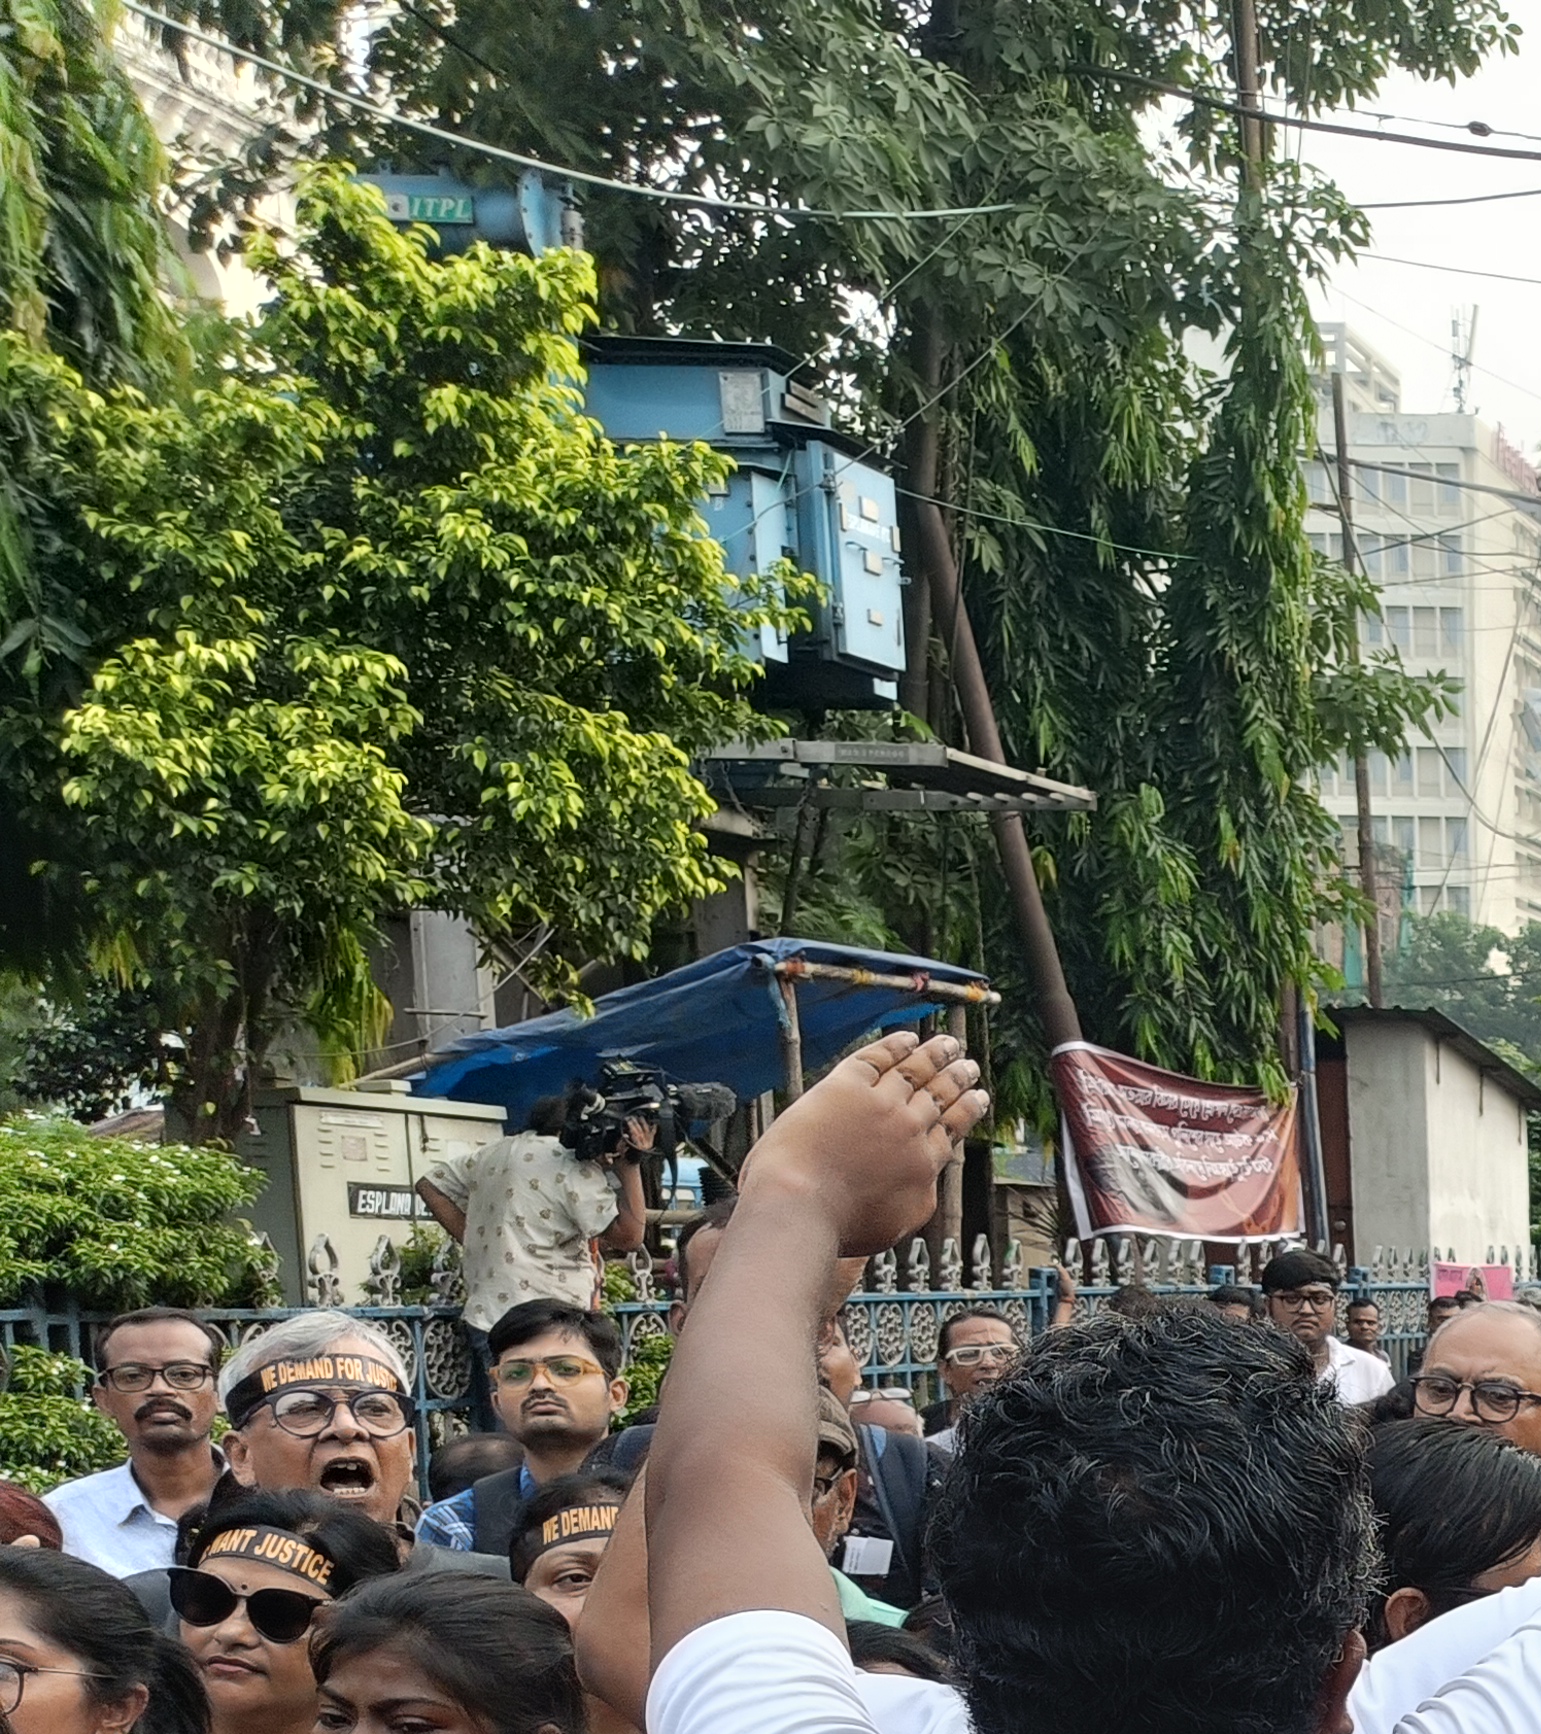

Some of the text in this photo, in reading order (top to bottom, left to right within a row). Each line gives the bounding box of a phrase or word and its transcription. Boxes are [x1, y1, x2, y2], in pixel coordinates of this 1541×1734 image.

[260, 1365, 278, 1393] WE
[278, 1357, 334, 1385] DEMAND
[336, 1357, 365, 1381] FOR
[543, 1515, 560, 1545] WE
[254, 1533, 335, 1586] JUSTICE
